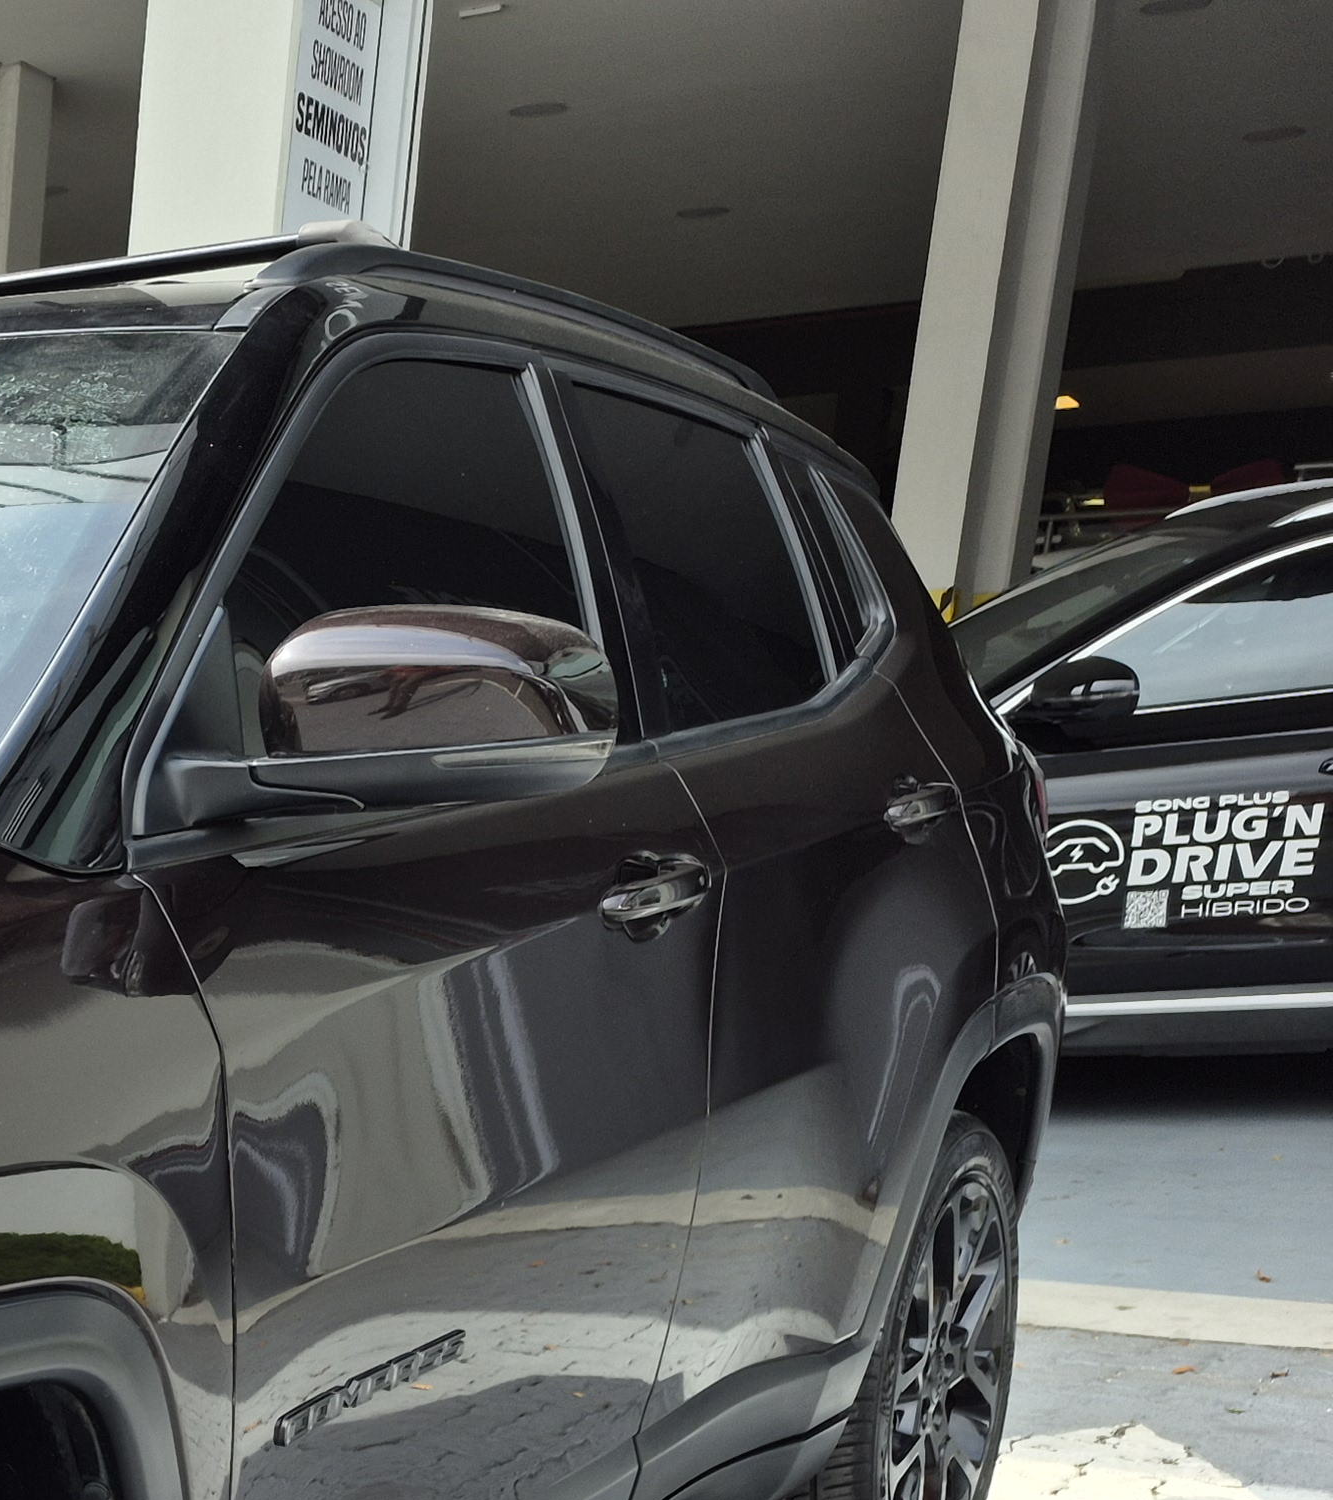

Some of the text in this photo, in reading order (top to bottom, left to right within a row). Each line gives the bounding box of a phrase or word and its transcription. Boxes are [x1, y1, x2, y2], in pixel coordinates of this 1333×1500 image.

[318, 0, 367, 52] ACESSO AO
[310, 39, 364, 106] SHOWROOM
[295, 92, 367, 166] SEMINOVOS
[301, 158, 350, 215] PELA RAMPA
[1136, 790, 1290, 814] SONG PLUS
[1127, 838, 1320, 886] DRIVE
[1181, 880, 1294, 900] SUPER
[1181, 897, 1310, 919] HÍBRIDO
